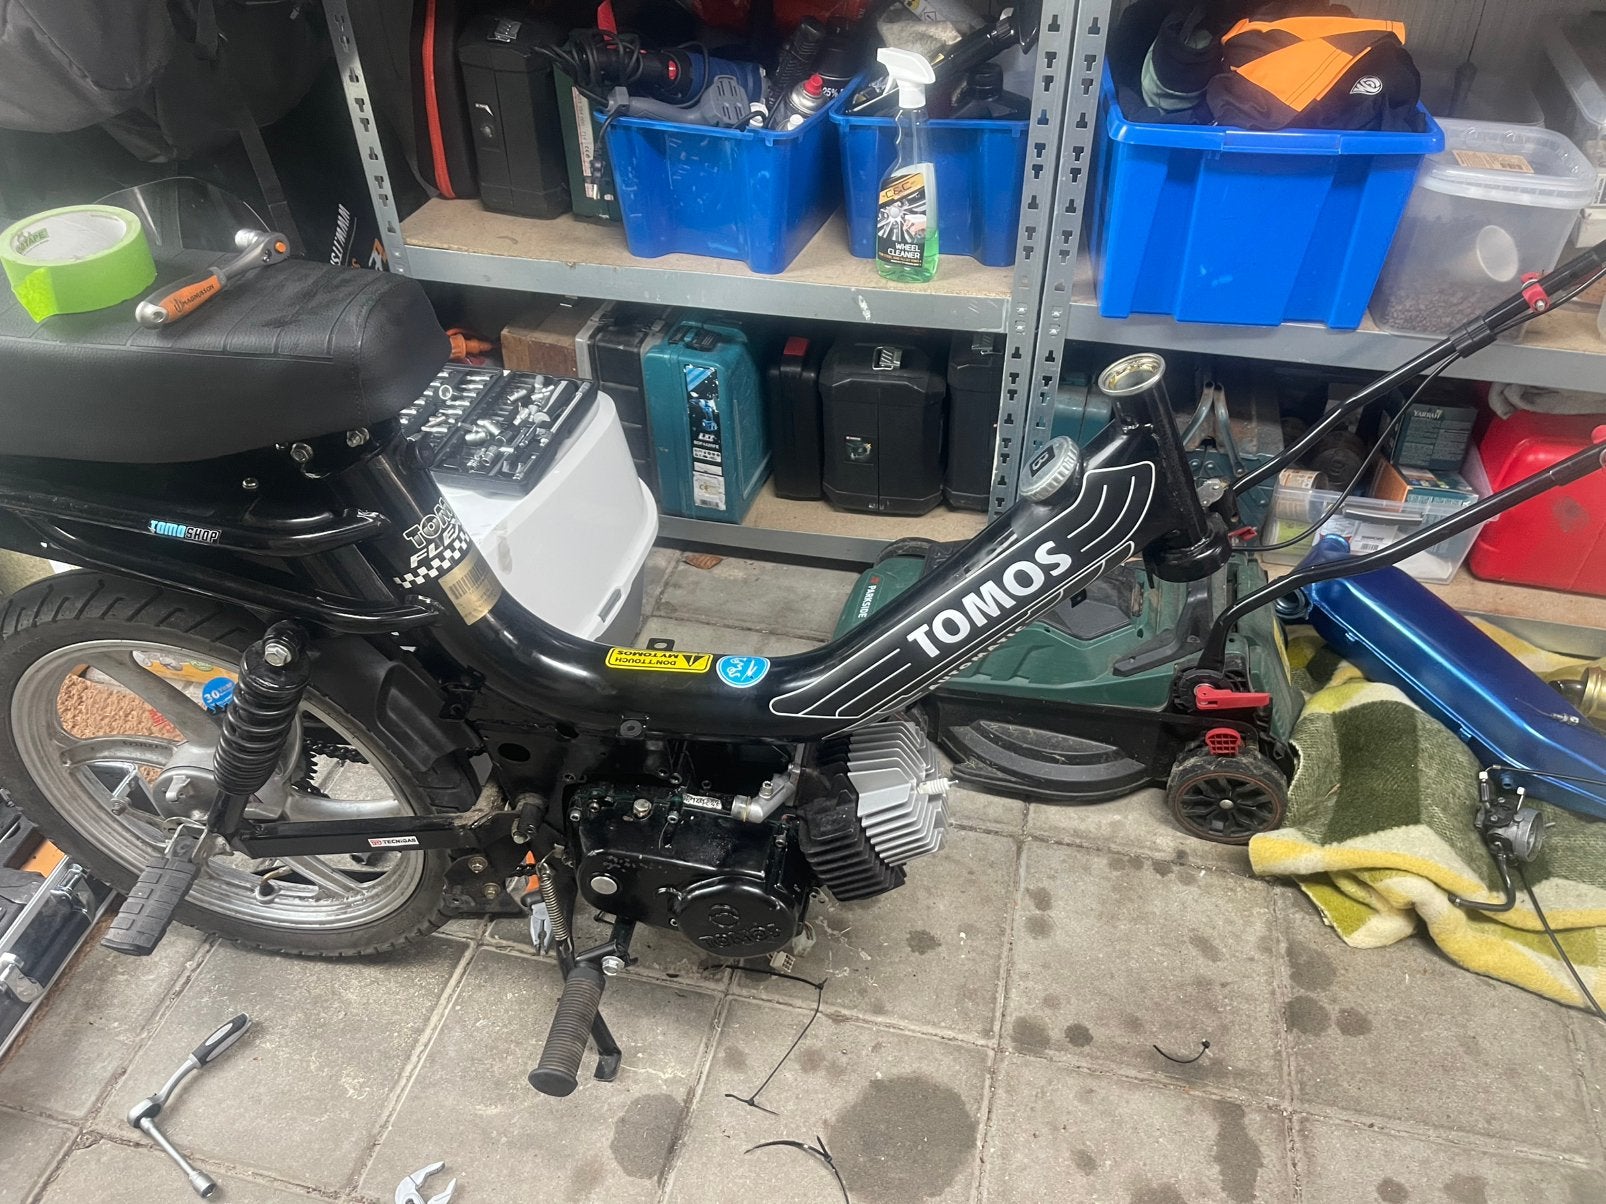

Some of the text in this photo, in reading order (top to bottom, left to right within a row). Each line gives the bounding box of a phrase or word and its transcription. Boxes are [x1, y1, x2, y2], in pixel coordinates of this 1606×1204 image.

[895, 242, 920, 252] WHEEL
[887, 248, 921, 259] CLEANER
[857, 585, 877, 618] PARKSIDE
[906, 540, 1073, 658] TOMOS
[616, 650, 660, 658] TOMOS
[928, 625, 1026, 691] AUTOMATIC
[614, 657, 677, 666] DON'T TOUCH
